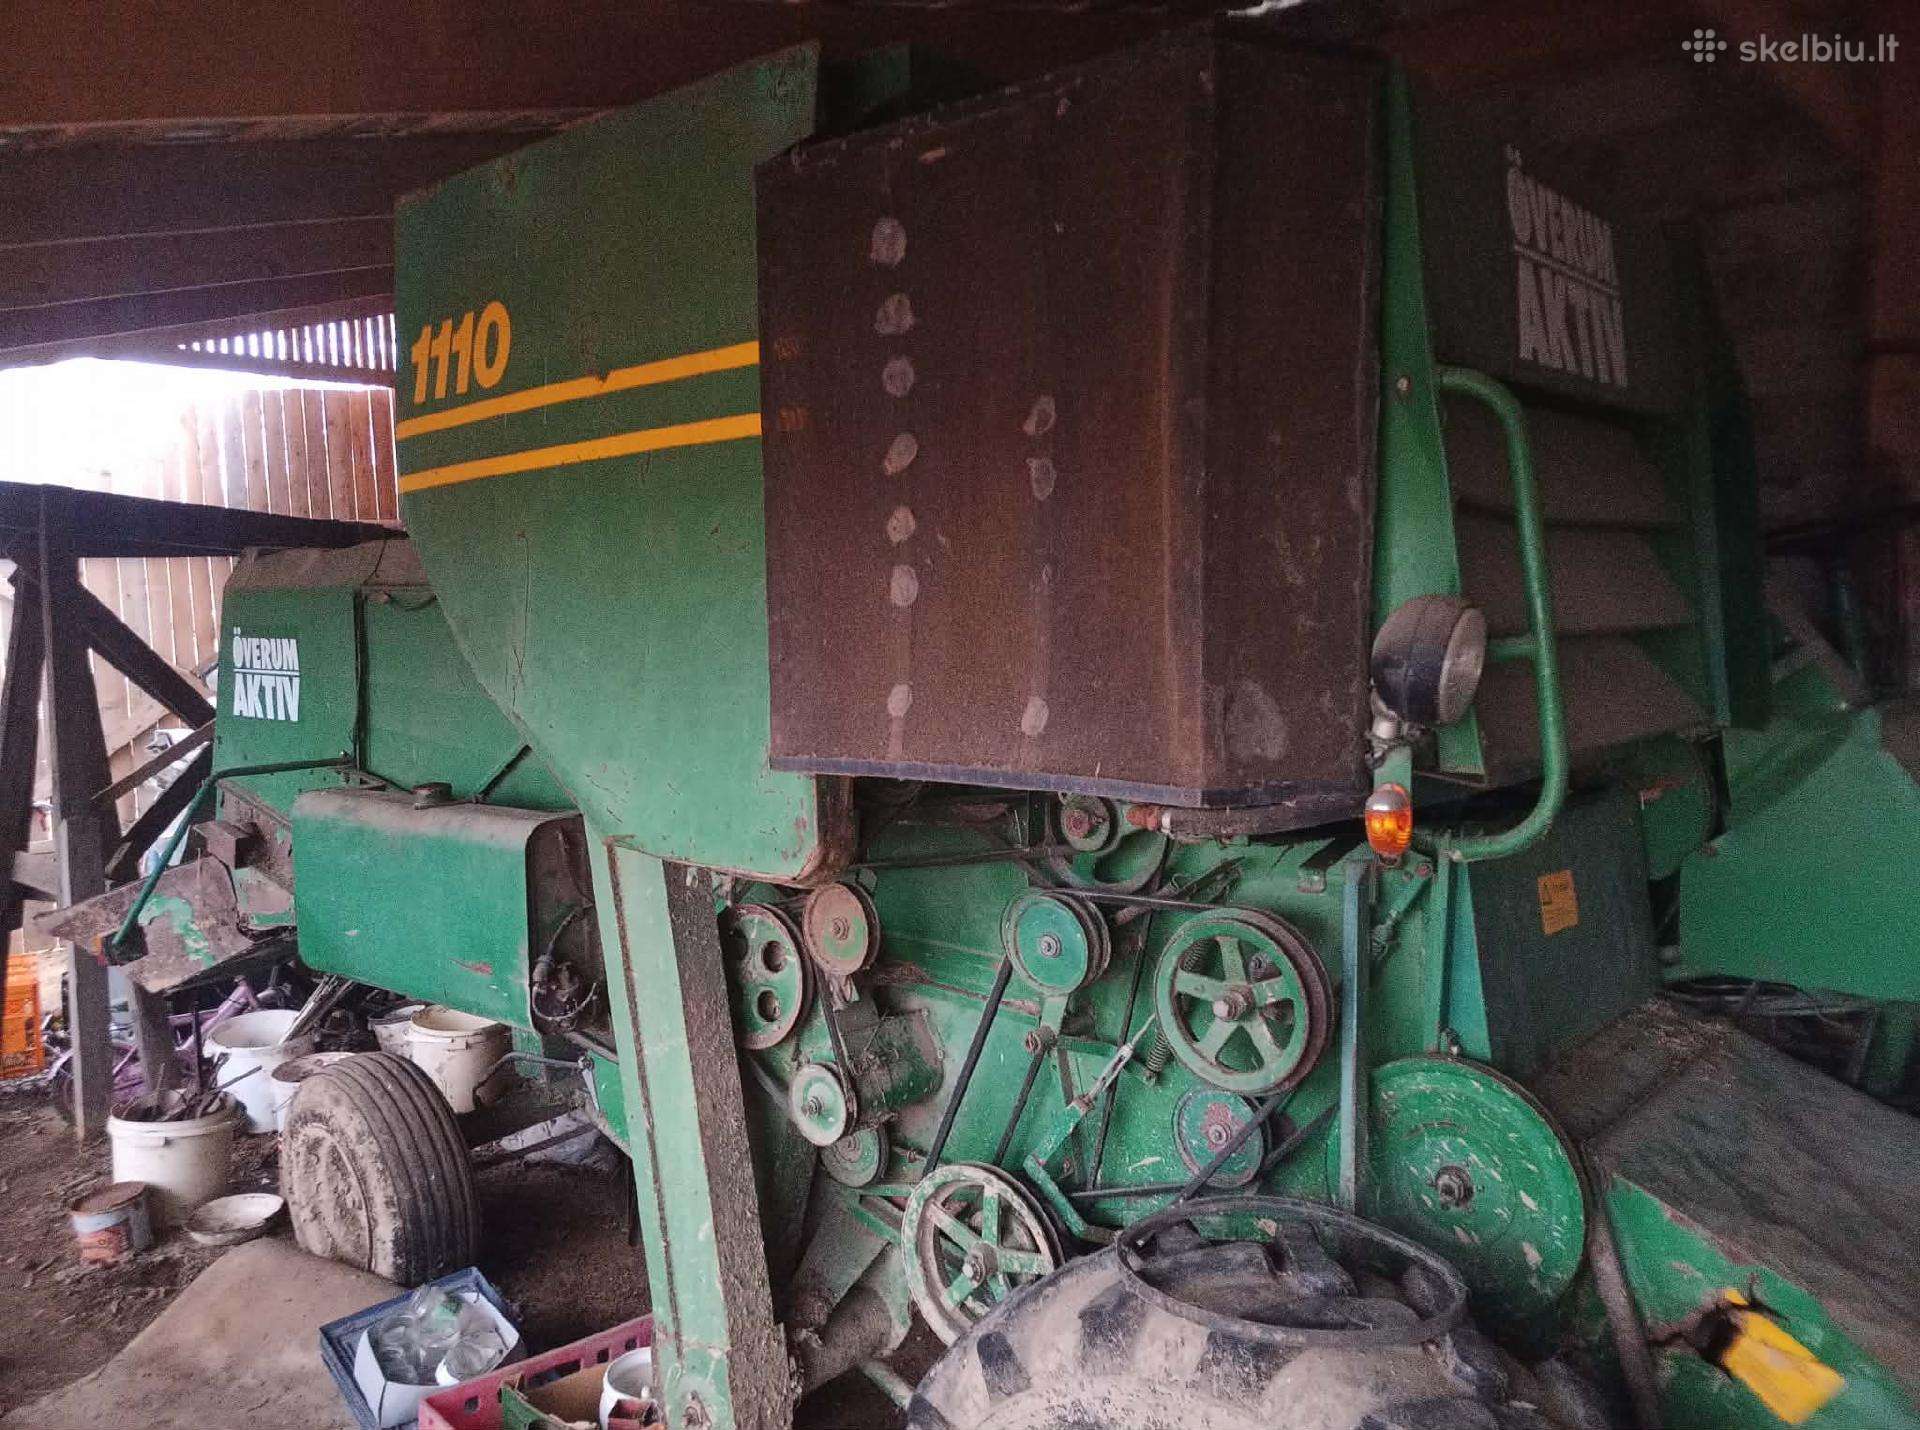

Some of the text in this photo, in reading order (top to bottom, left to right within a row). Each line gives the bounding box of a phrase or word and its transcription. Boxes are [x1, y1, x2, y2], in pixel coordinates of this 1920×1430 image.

[411, 300, 511, 404] 1110
[1518, 256, 1628, 388] AKTIV
[233, 626, 299, 671] ÖVERUM
[233, 672, 300, 722] AKTIV
